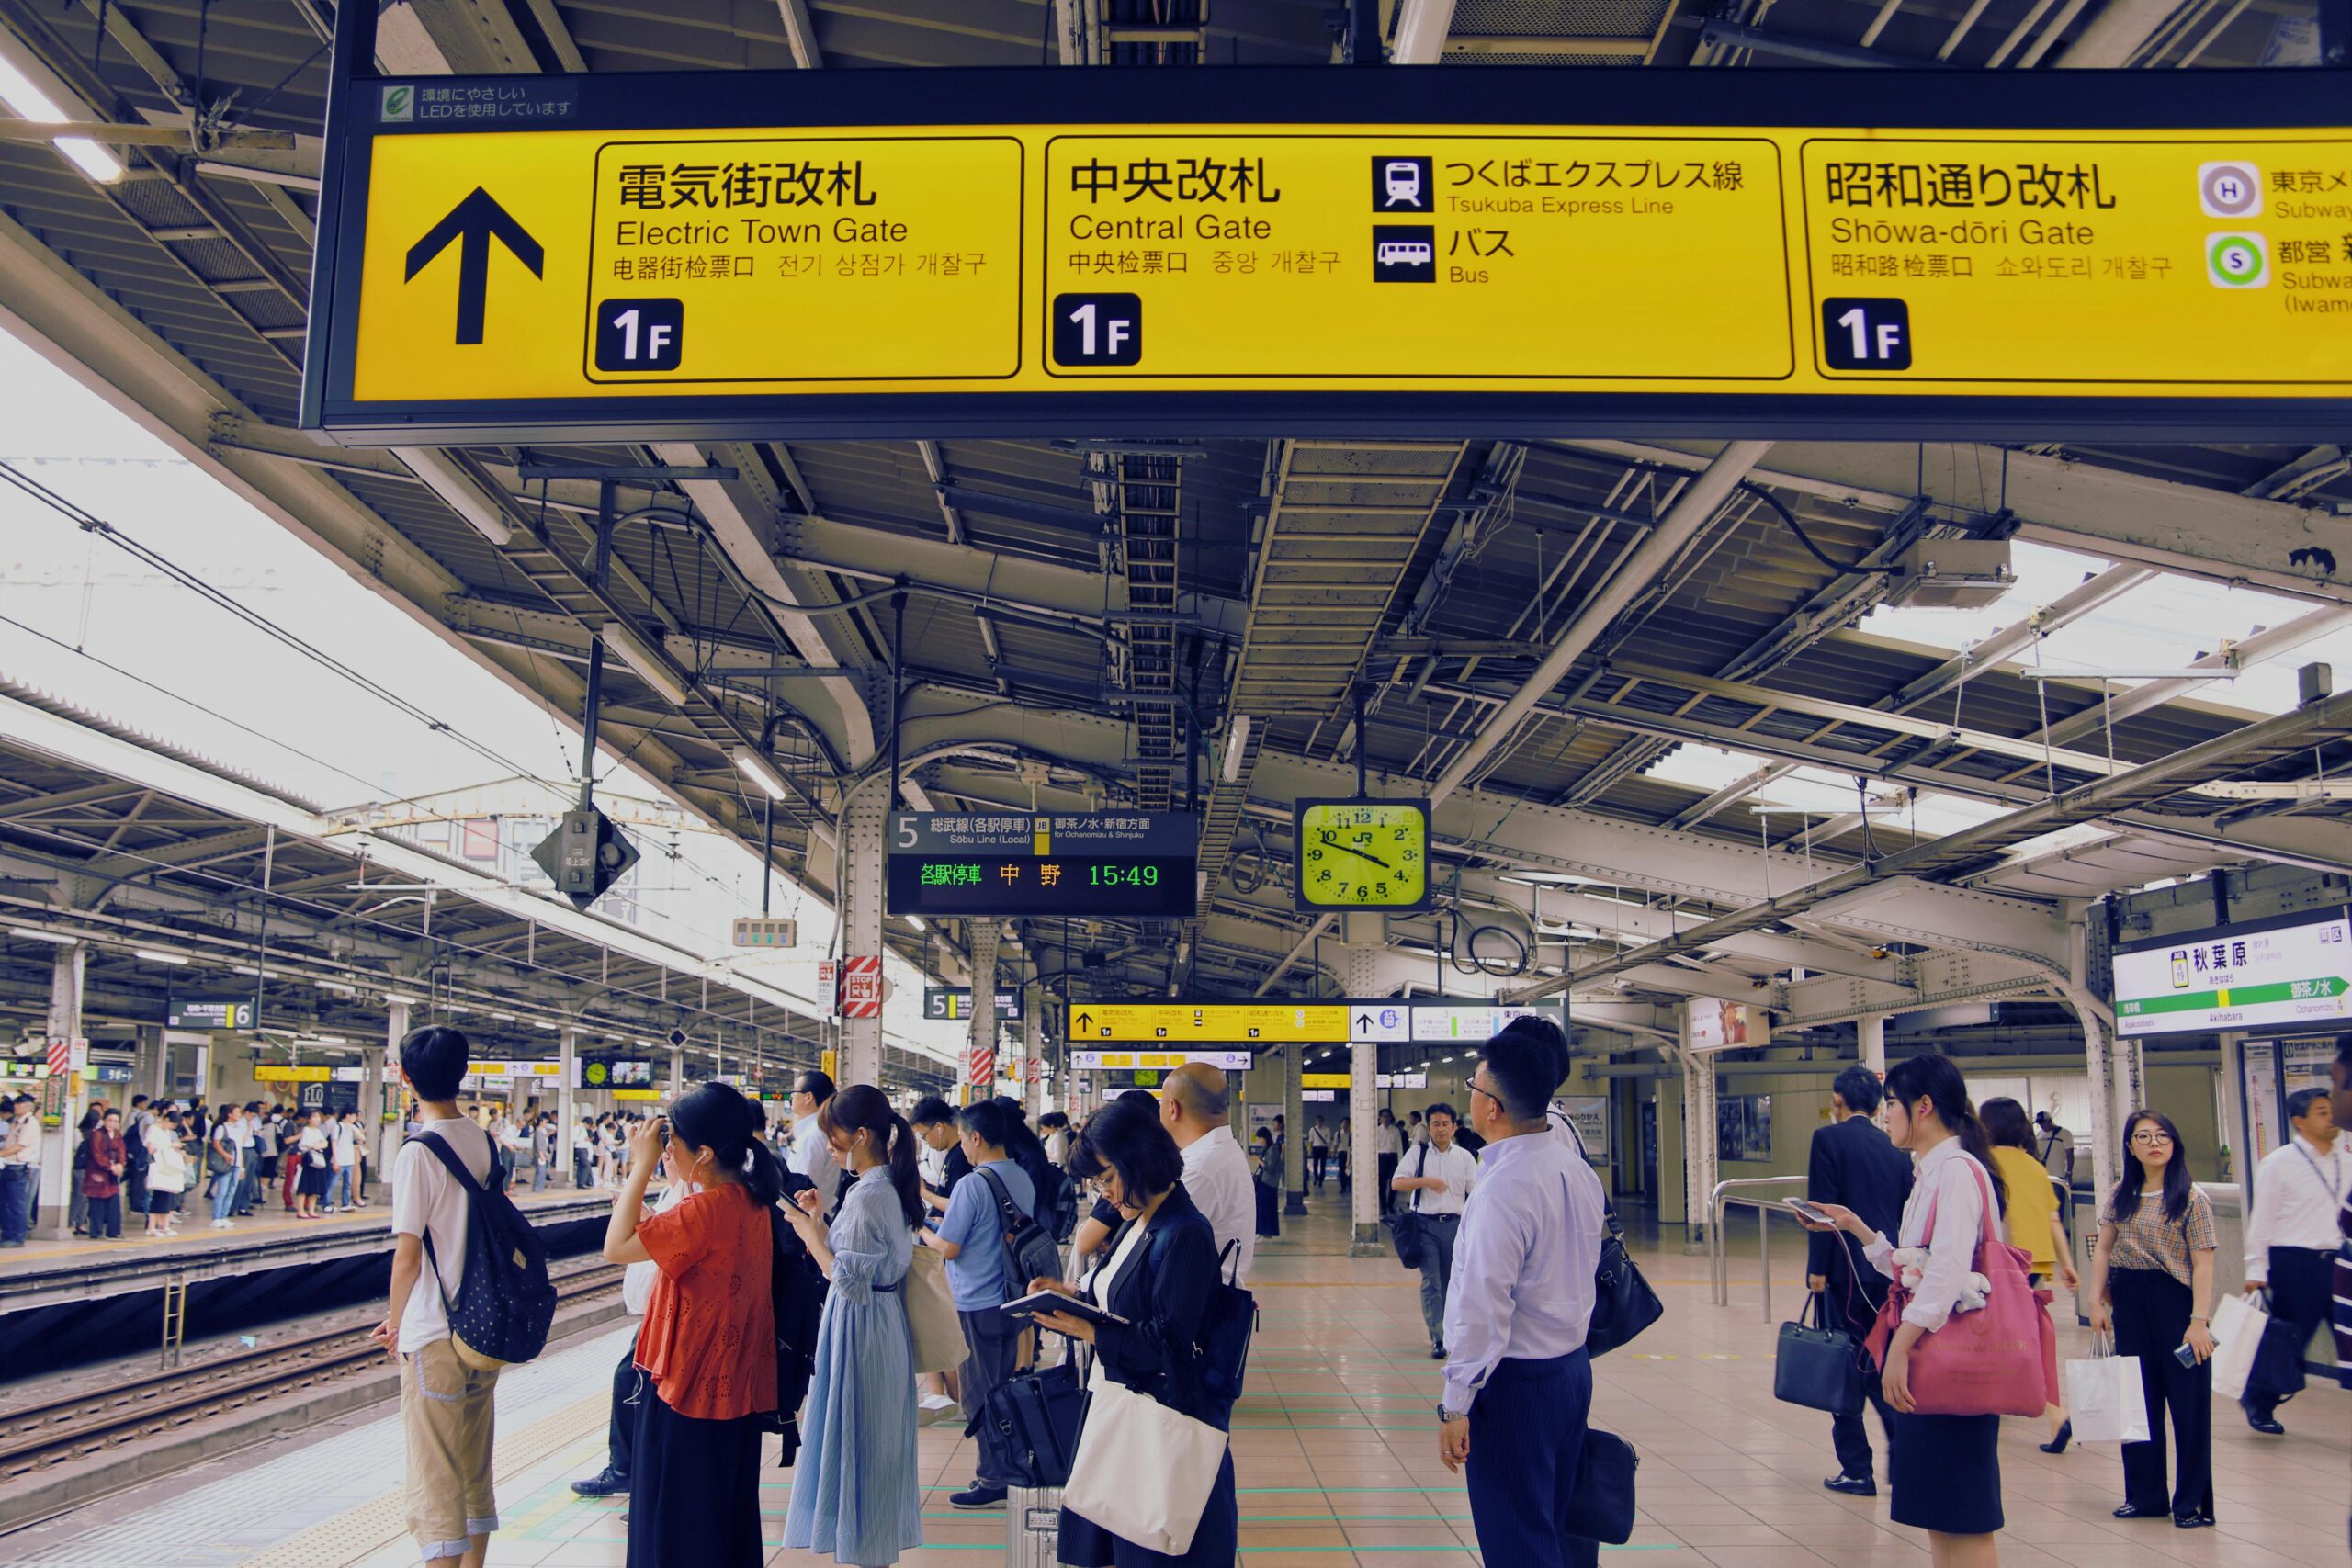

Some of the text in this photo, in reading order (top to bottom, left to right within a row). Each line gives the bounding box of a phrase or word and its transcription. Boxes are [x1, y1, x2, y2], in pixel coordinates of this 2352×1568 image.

[421, 87, 525, 102] 環境にやさしい
[420, 102, 571, 118] LEDを使用しています
[618, 159, 877, 210] 電気街改札
[1070, 155, 1281, 205] 中央改札
[1443, 158, 1745, 192] つくばエクスプレス線
[2269, 170, 2352, 195] 東京メ
[1825, 161, 2117, 210] 昭和通り改札
[2220, 182, 2238, 198] H
[1447, 196, 1674, 217] Tsukuba Express Line
[616, 218, 908, 246] Electric Town Gate
[1069, 215, 1272, 241] Central Gate
[1831, 218, 2095, 246] Shōwa-dōri Gate
[1447, 228, 1515, 258] バス
[2278, 239, 2332, 265] 都営
[612, 254, 755, 280] 电器街检票口
[777, 251, 988, 279] 전기 상점가 개찰구
[1069, 249, 1189, 275] 中央检票口
[1211, 249, 1341, 275] 중앙 개찰구
[1830, 254, 1974, 279] 昭和路检票口
[1996, 254, 2174, 280] 쇼와도리 개찰구
[2230, 252, 2244, 269] S
[1449, 266, 1489, 284] Bus
[2284, 292, 2352, 314] (Iwam
[612, 309, 672, 360] 1F
[1069, 303, 1130, 355] 1F
[1838, 308, 1901, 360] 1F
[931, 817, 1030, 834] 総武線(各駅停車)
[1036, 819, 1048, 830] JB
[1055, 817, 1149, 830] 御茶ノ水・新宿方面
[1337, 818, 1351, 829] 11
[1354, 813, 1371, 824] 12
[899, 816, 918, 849] 5
[950, 833, 1031, 846] Sōbu Line (Local)
[1115, 831, 1144, 840] Shinjuku
[1320, 830, 1337, 842] 10
[1352, 832, 1373, 843] JR
[1394, 829, 1405, 840] 2
[1312, 849, 1323, 861] 9
[1402, 850, 1413, 861] 3
[921, 863, 982, 886] 各駅停車
[1090, 865, 1159, 886] 15:49
[1320, 869, 1332, 881] 8
[1394, 870, 1405, 881] 4
[1338, 882, 1349, 894] 7
[1357, 886, 1368, 897] 6
[1375, 882, 1387, 894] 5
[2193, 941, 2248, 974] 秋葉原
[2177, 971, 2185, 981] 19
[236, 1005, 250, 1025] 6
[933, 995, 946, 1015] 5
[2209, 1012, 2244, 1023] Akihabara
